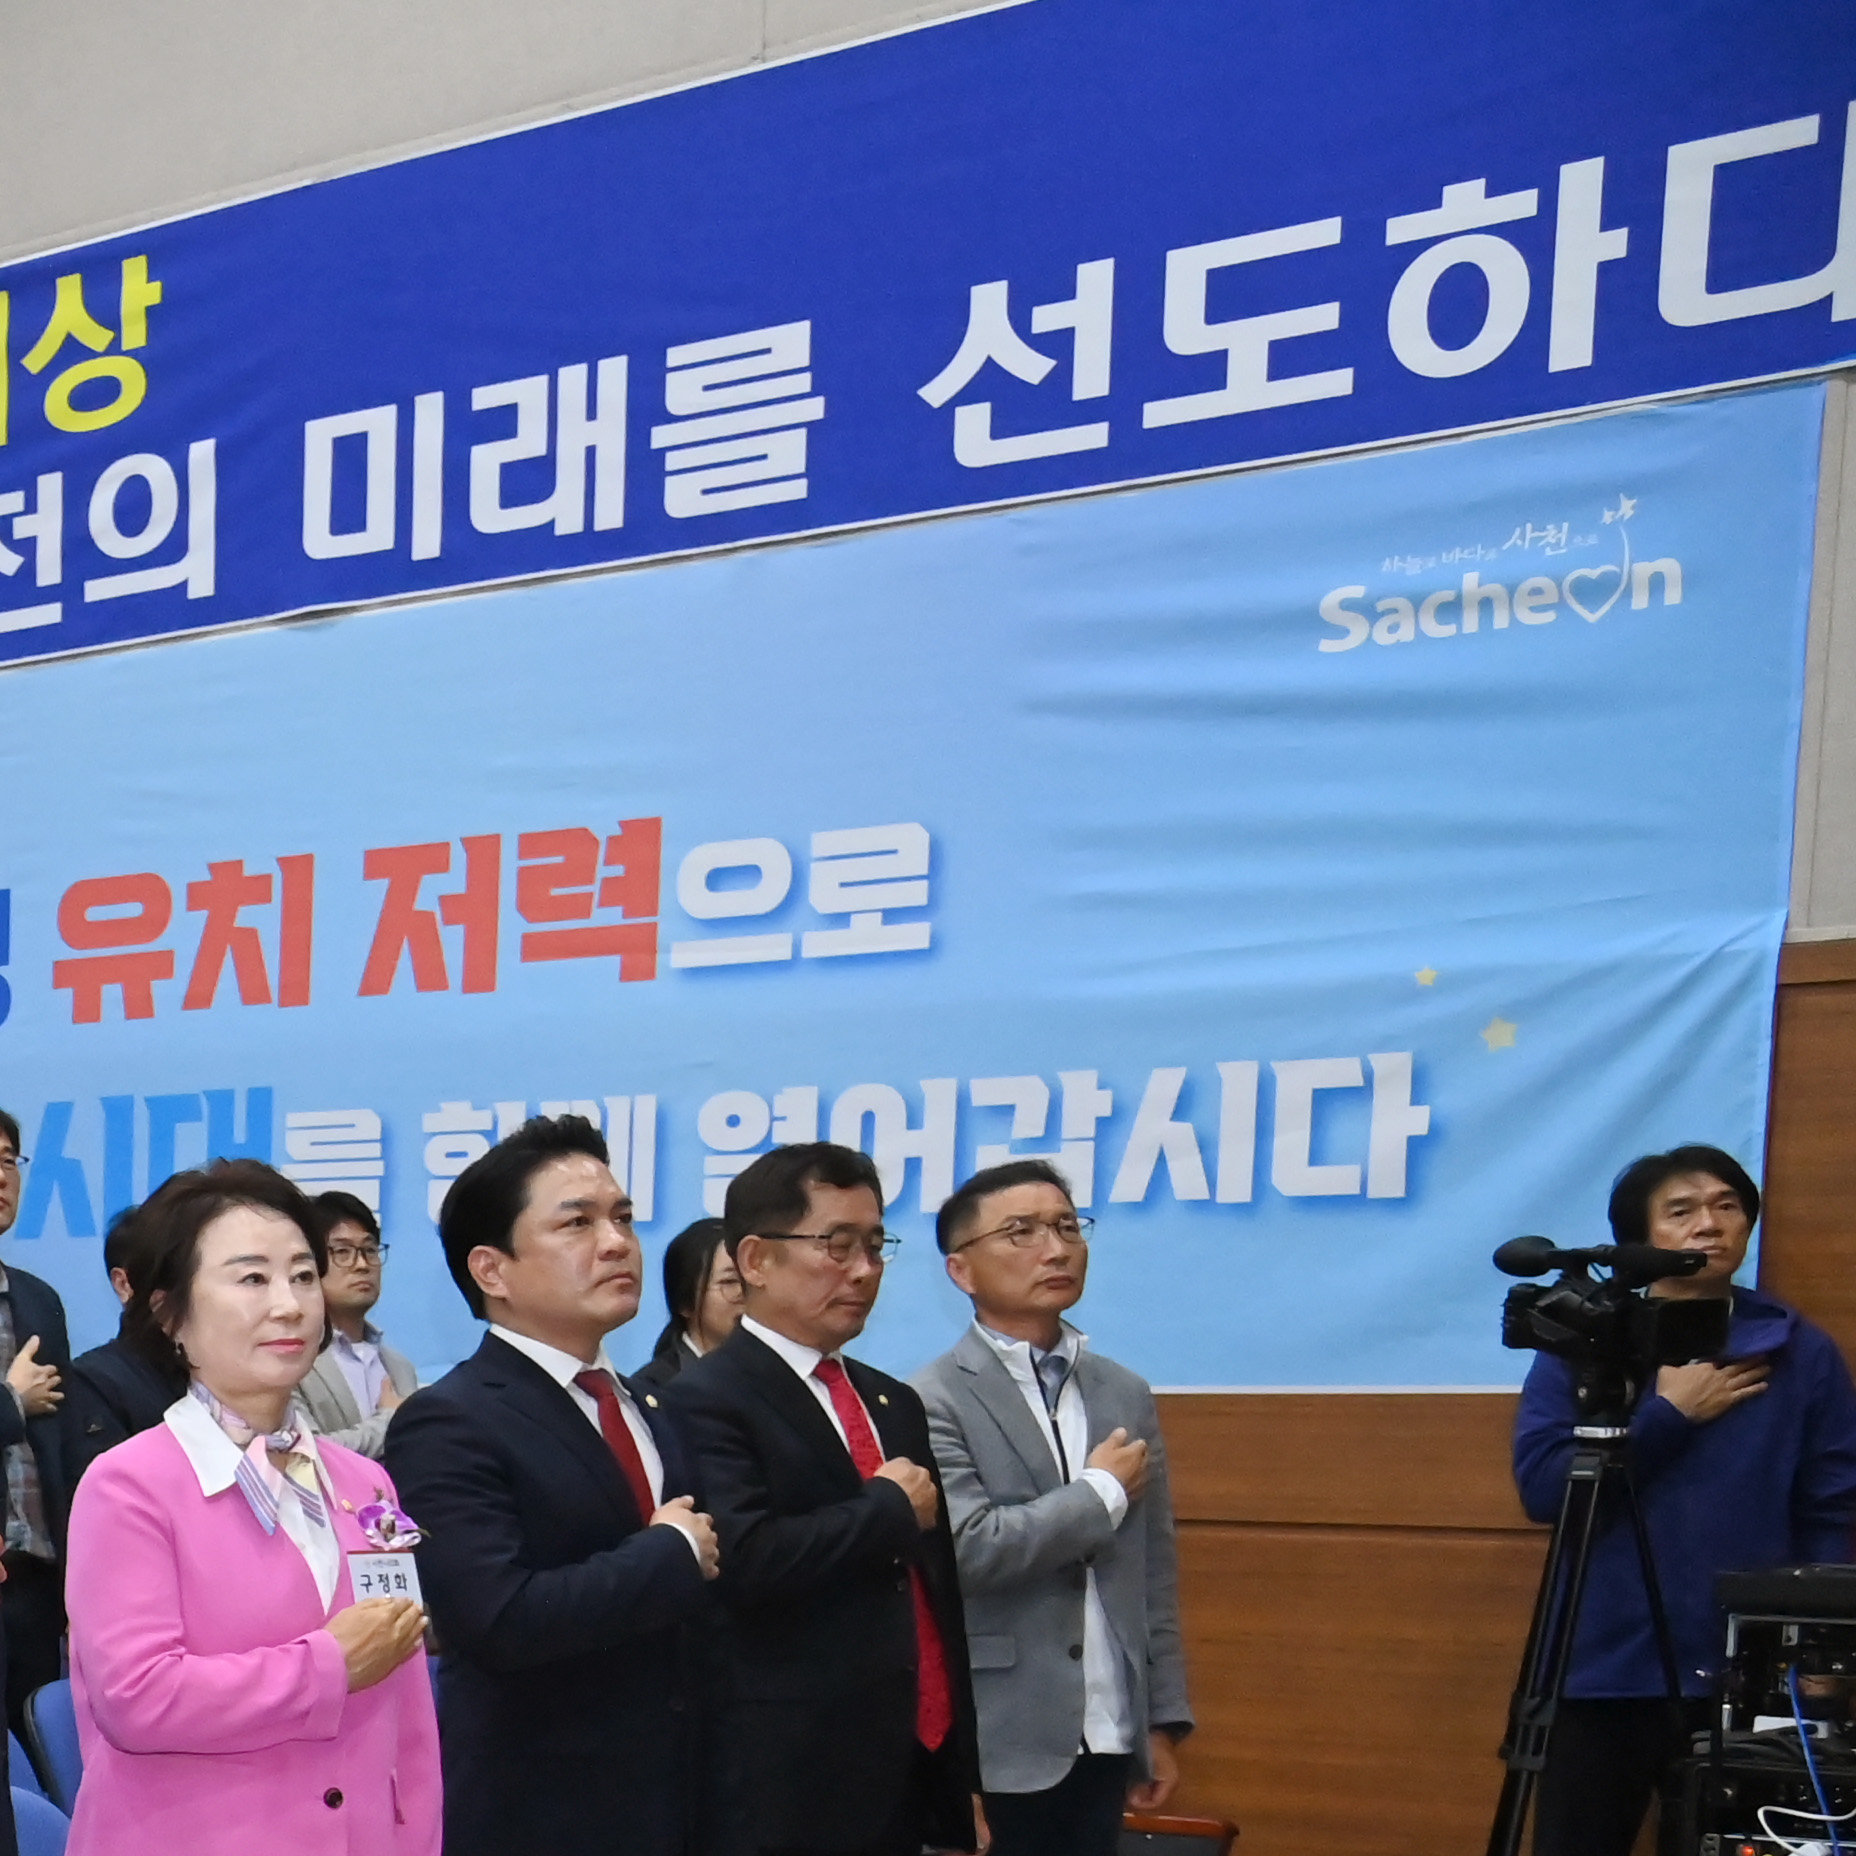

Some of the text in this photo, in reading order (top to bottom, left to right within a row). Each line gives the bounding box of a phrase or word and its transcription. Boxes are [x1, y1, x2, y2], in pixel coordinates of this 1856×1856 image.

[301, 319, 825, 561] 미래를
[916, 98, 1856, 470] 선도하다
[53, 854, 314, 1026] 유치
[359, 814, 932, 998] 저력으로
[697, 1050, 1430, 1215] 열어갑시다
[359, 1572, 408, 1594] 구정화
